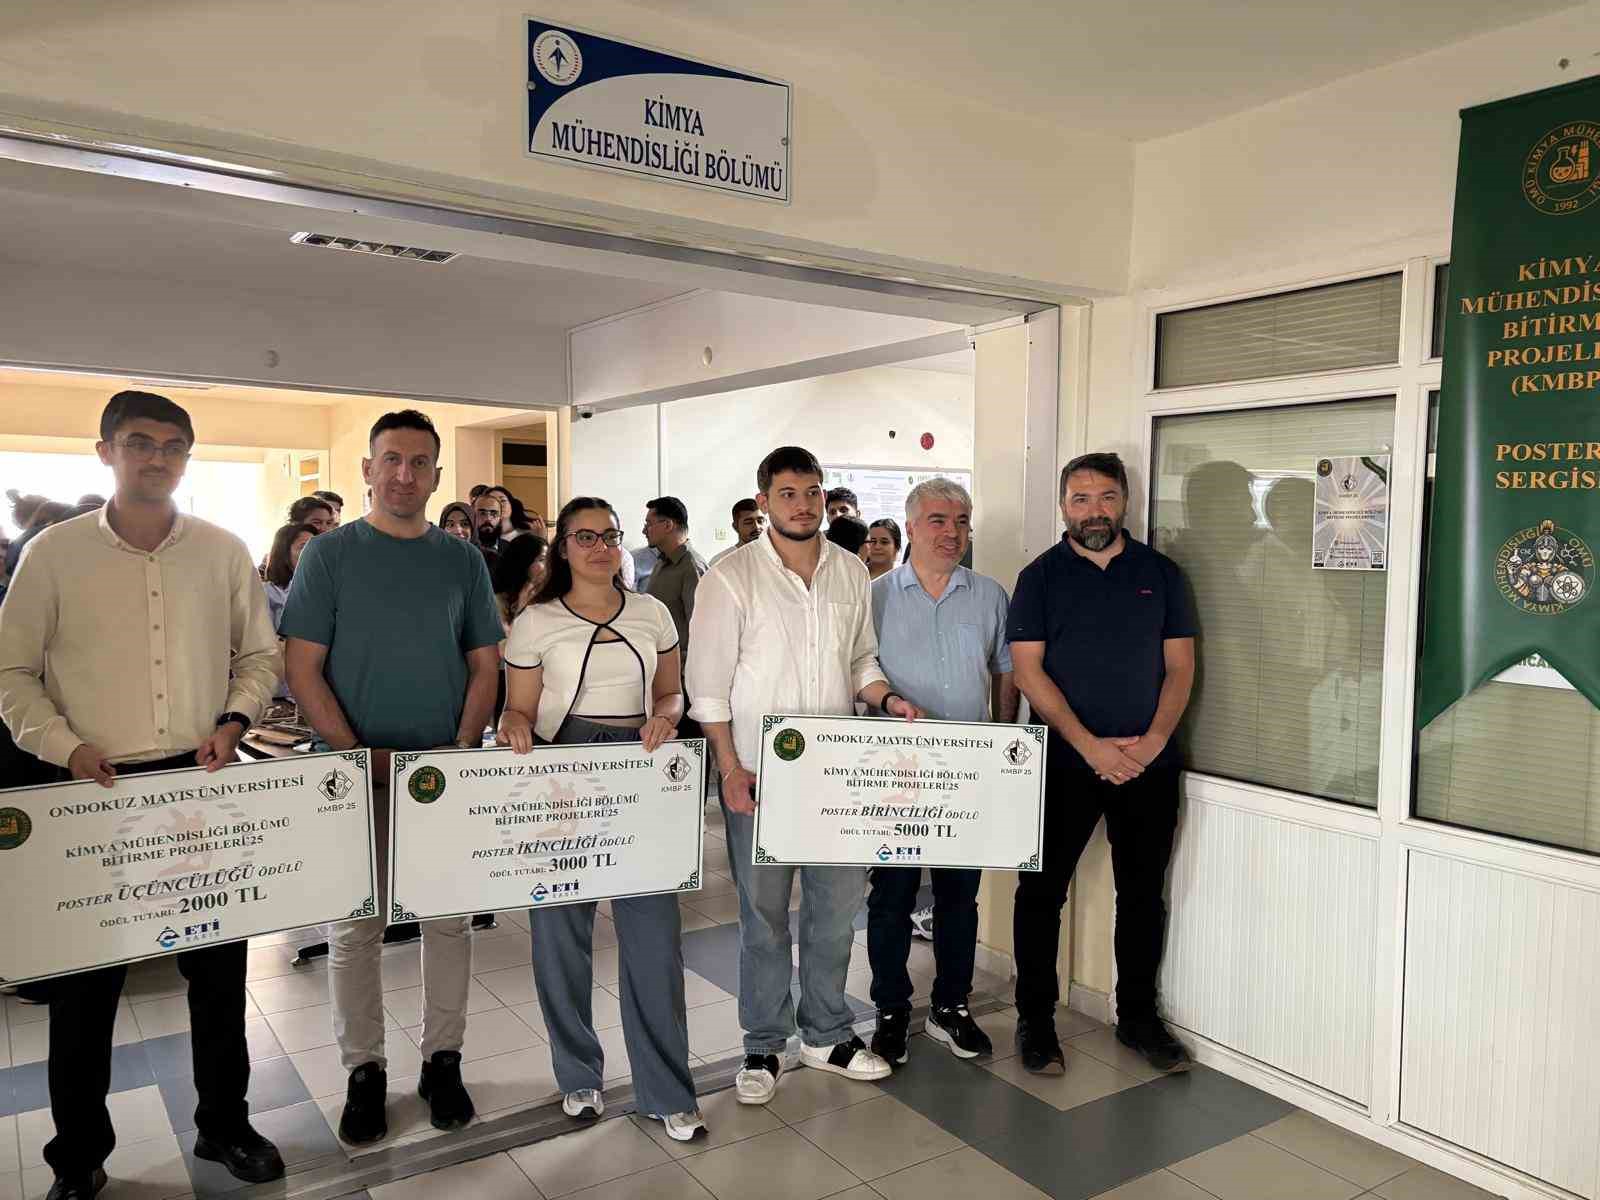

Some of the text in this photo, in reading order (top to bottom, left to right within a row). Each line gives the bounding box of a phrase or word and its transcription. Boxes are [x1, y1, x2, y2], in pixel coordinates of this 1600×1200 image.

[644, 94, 705, 137] KİMYA
[551, 119, 783, 193] MÜHENDİSLİĞİ BÖLÜMÜ
[1554, 199, 1579, 212] 1992
[1495, 442, 1600, 462] POSTER
[1495, 467, 1600, 489] SERGİS
[817, 734, 993, 749] ONDOKUZ MAYIS ÜNİVERSİTESİ
[459, 758, 654, 778] ONDOKUZ MAYIS ÜNİVERSİTESİ
[823, 766, 861, 777] KİMYA
[936, 769, 980, 781] BÖLÜMÜ
[661, 784, 692, 793] KMBP 25
[846, 778, 889, 788] BİTİRME
[49, 774, 305, 818] ONDOKUZ MAYIS ÜNİVERSİTESİ
[468, 793, 640, 815] KİMYA MÜHENDİSLİĞİ BÖLÜMÜ
[317, 801, 357, 814] KMBP 25
[821, 804, 980, 820] POSTER BİRİNCİLİĞİ ÖDÜLÜ
[495, 814, 544, 826] BİTİRME
[65, 816, 291, 859] KİMYA MÜHENDİSLİĞİ BÖLÜMÜ
[894, 823, 929, 837] 5000
[934, 824, 957, 838] TL
[471, 834, 635, 859] POSTER İKİNCİLİĞİ ÖDÜLÜ
[896, 845, 921, 855] ETİ
[102, 849, 166, 867] BİTİRME
[489, 870, 512, 879] ÖDÜL
[549, 855, 588, 872] 3000
[592, 853, 617, 868] TL
[56, 860, 304, 911] POSTER ÜÇÜNCÜLÜĞÜ ÖDÜLÜ
[552, 879, 579, 892] ETİ
[99, 916, 131, 928] ÖDÜL
[179, 891, 229, 914] 2000
[234, 886, 268, 903] TL
[184, 918, 220, 936] ETİ
